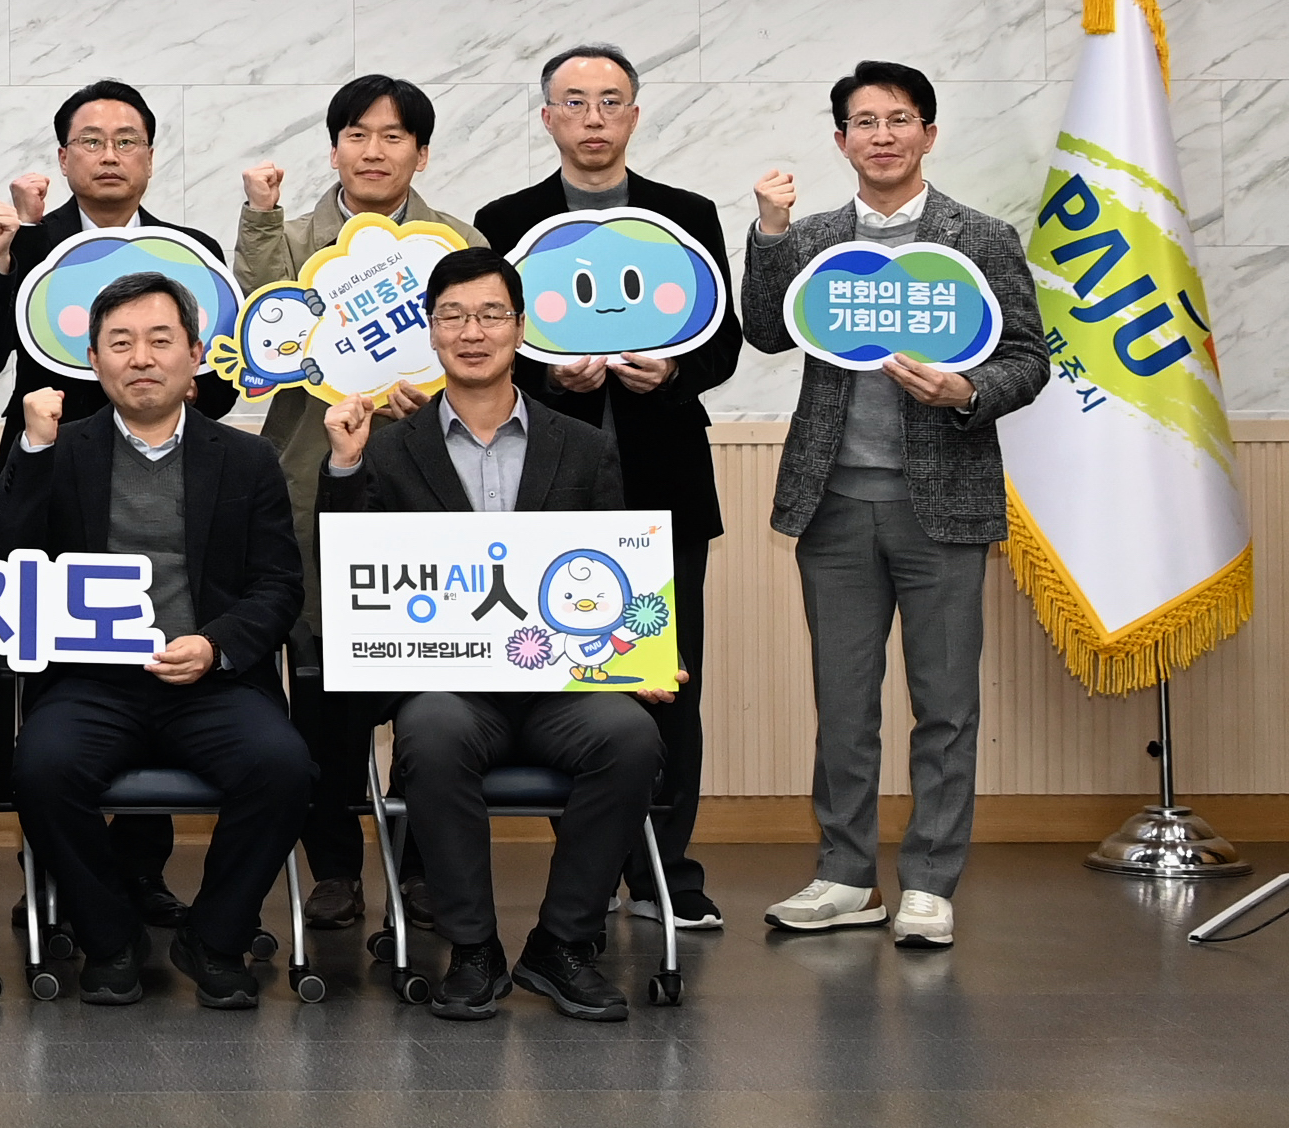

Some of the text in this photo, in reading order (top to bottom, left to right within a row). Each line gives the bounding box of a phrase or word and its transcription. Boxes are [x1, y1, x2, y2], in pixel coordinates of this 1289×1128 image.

[386, 252, 403, 266] 도시
[1038, 173, 1192, 377] PAJU
[334, 265, 420, 328] 시민중심
[828, 280, 957, 306] 변화의 중심
[828, 308, 957, 335] 기회의 경기
[335, 336, 357, 355] 더
[357, 319, 398, 363] 큰
[244, 375, 264, 386] PAJU
[1044, 326, 1107, 413] 파주시
[618, 537, 650, 549] PAJU
[351, 641, 492, 659] 민생이 기본입니다!
